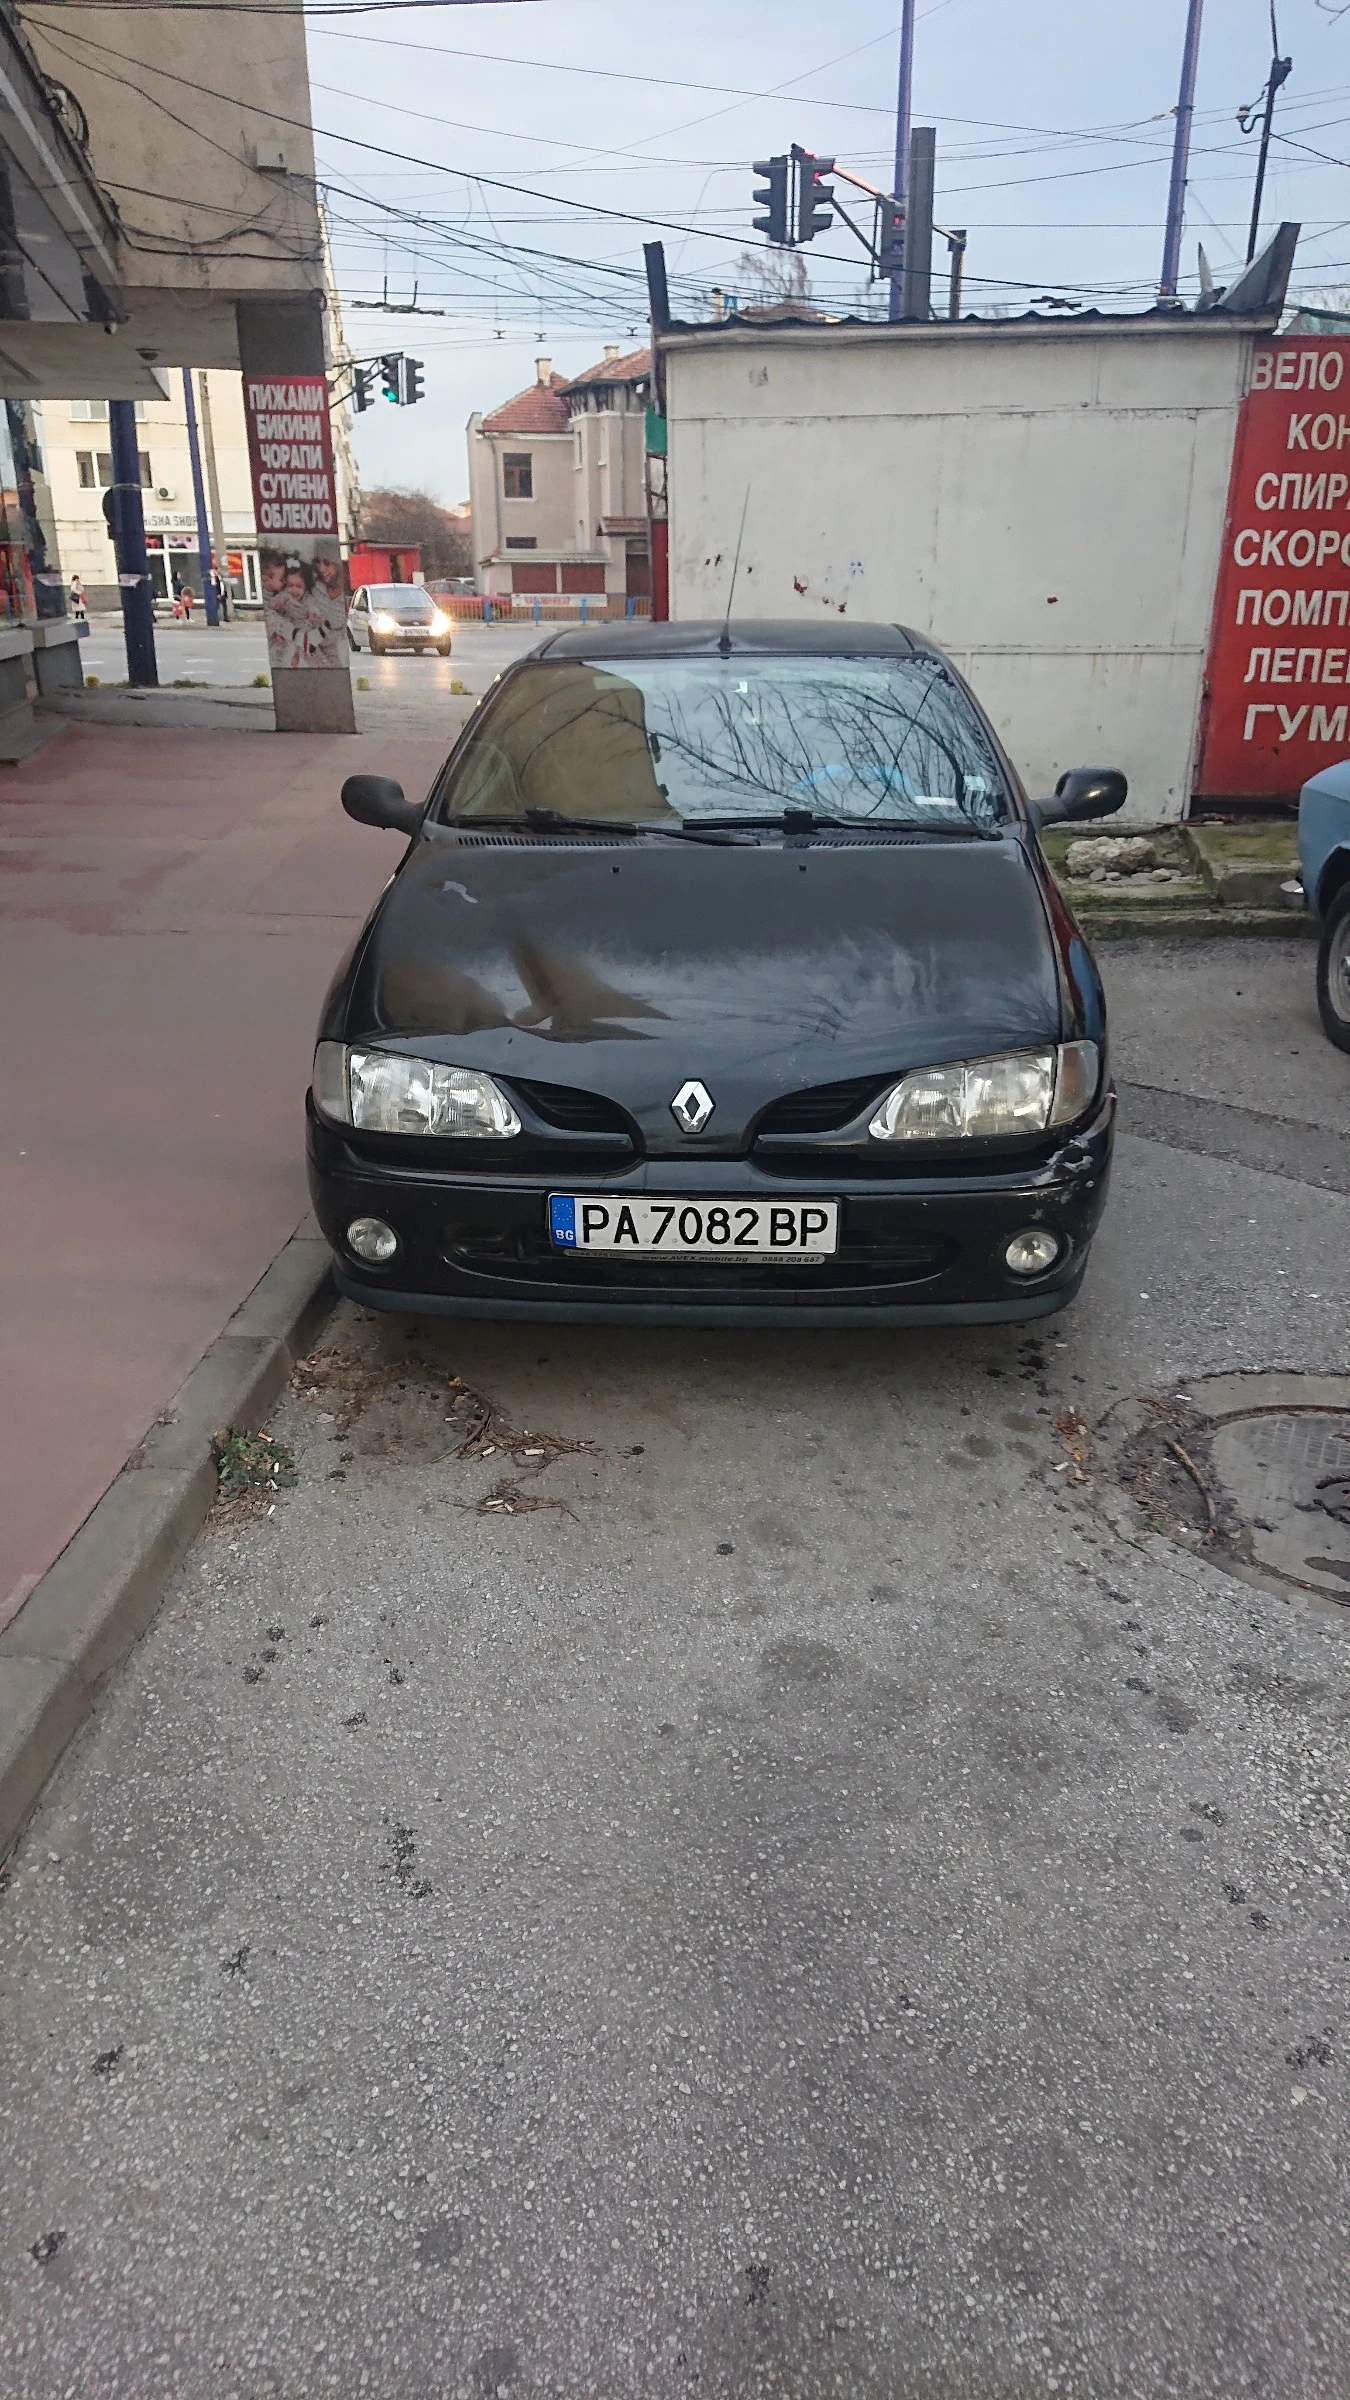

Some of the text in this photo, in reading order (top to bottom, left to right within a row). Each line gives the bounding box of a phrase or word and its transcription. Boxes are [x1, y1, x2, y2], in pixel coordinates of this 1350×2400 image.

[1251, 351, 1344, 391] ВЕЛО
[248, 383, 325, 411] ПИЖАМИ
[256, 413, 322, 440] БИКИНИ
[259, 443, 324, 470] ЧОРАПИ
[259, 473, 329, 499] СУТИЕНИ
[1254, 472, 1350, 510] СПИР
[260, 502, 333, 530] ОБЛЕКЛО
[1236, 589, 1350, 626] ПОМП
[1243, 647, 1350, 683] ЛЕПЕ
[1243, 704, 1350, 741] ГУМ
[555, 1229, 574, 1241] BG
[650, 1206, 759, 1245] 7082
